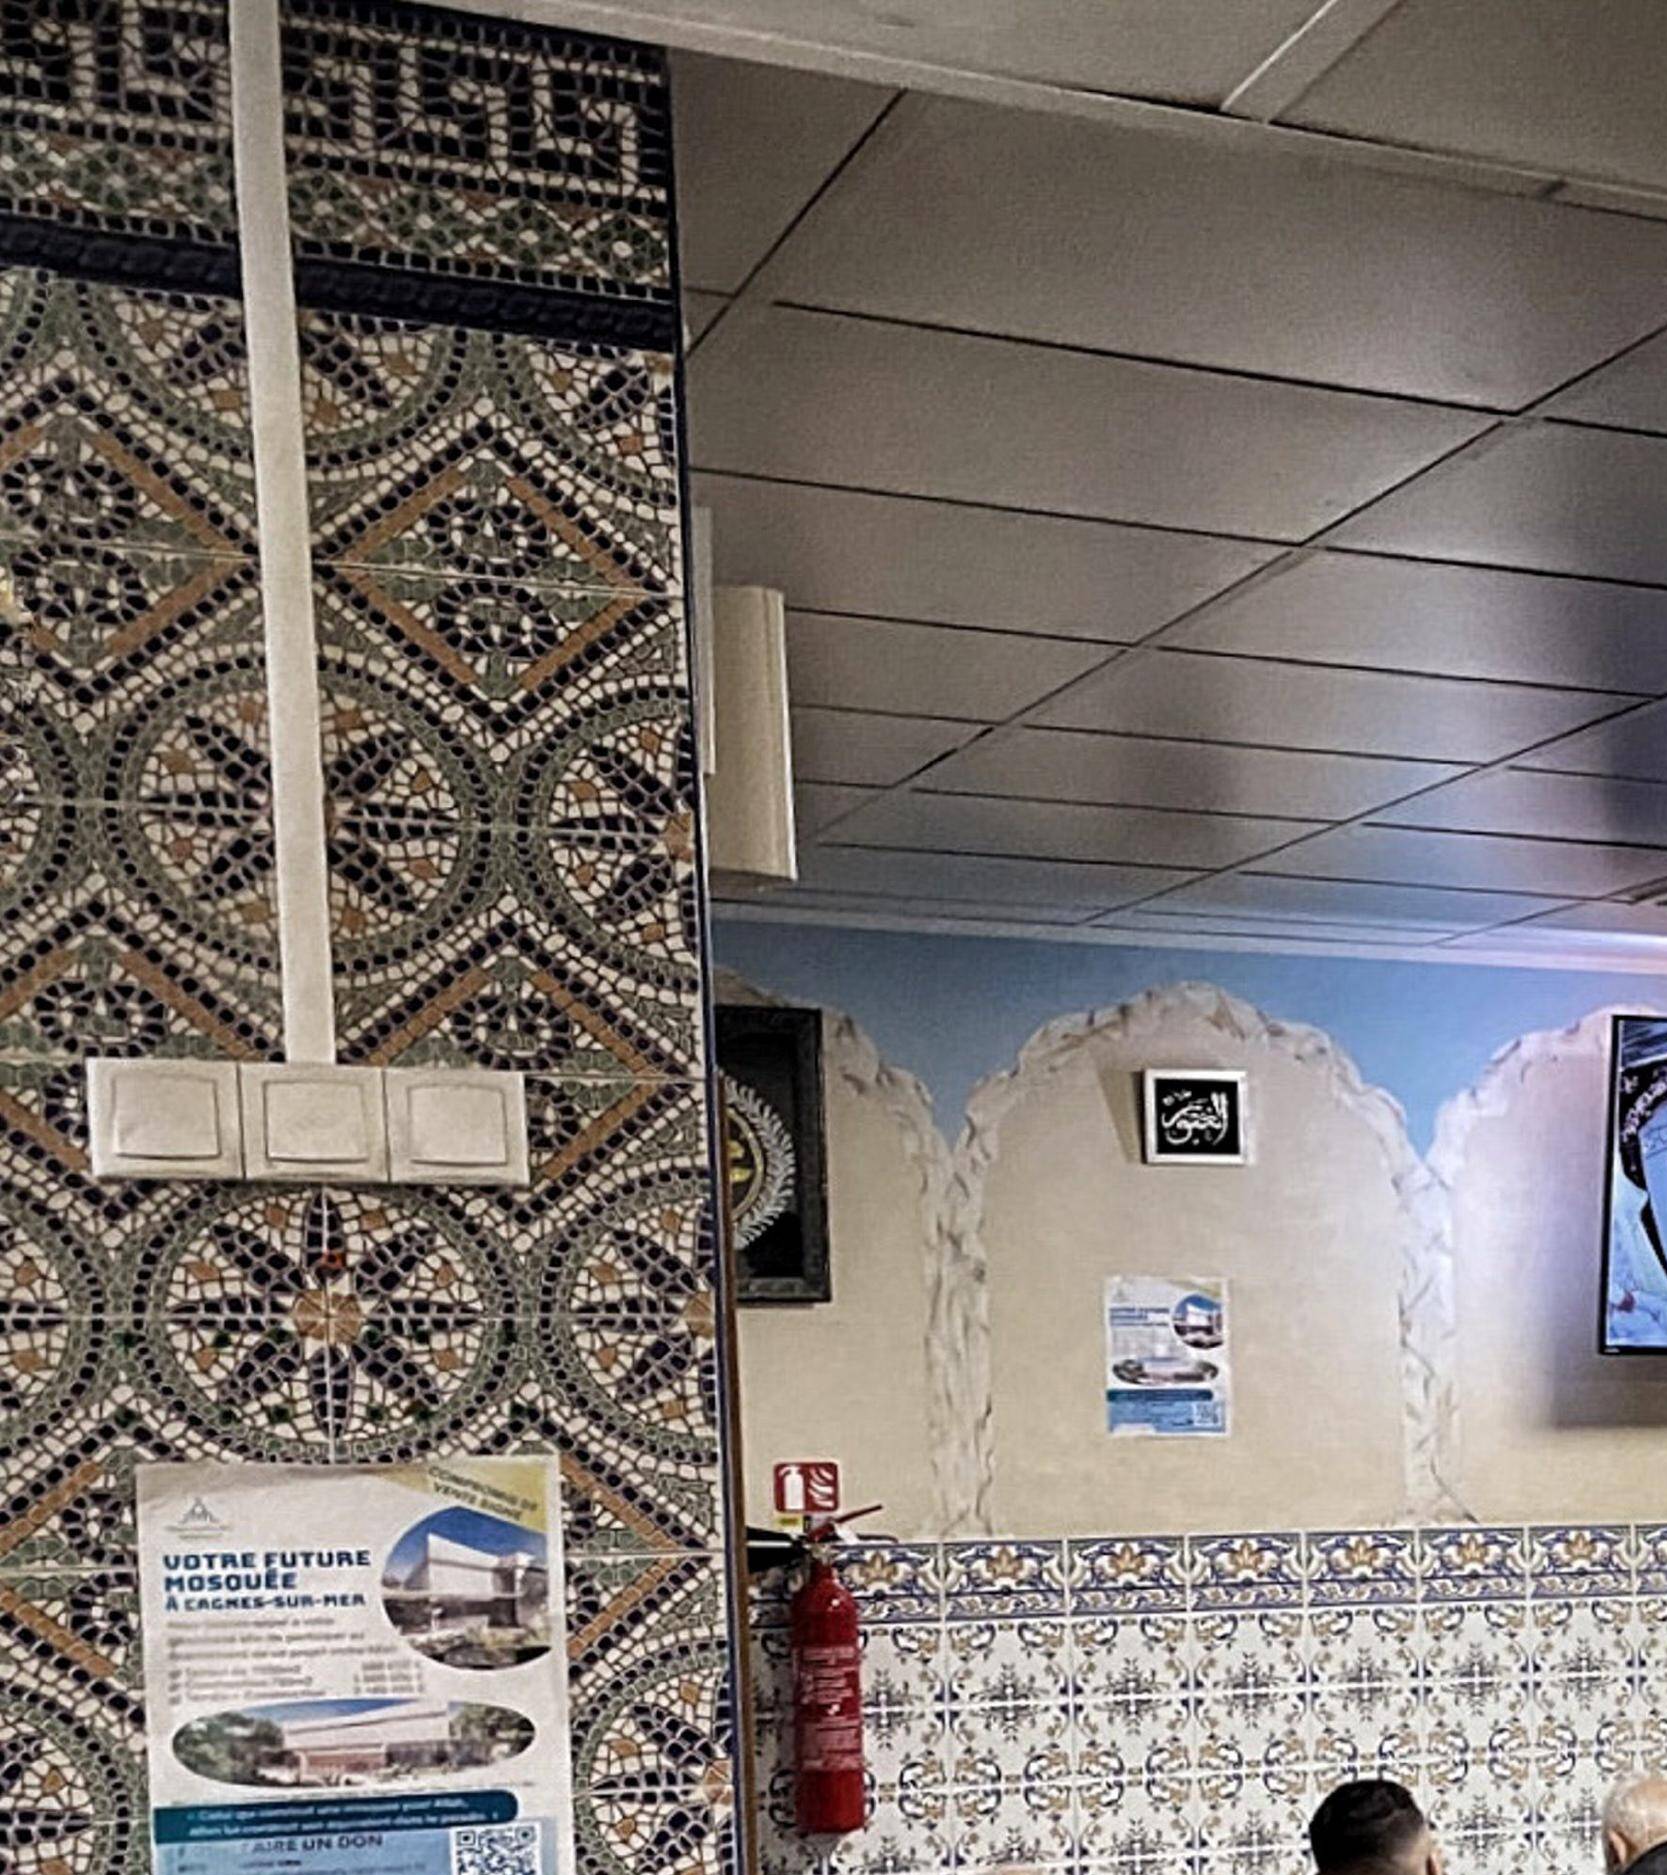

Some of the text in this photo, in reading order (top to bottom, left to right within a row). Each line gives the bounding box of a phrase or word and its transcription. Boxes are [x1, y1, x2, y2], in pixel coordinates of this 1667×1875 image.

[163, 1550, 371, 1570] VOTRE FUTURE
[164, 1569, 297, 1592] MOSQUÉE
[184, 1593, 366, 1611] CAGNES-SUR-MER
[302, 1837, 332, 1851] UN
[338, 1835, 383, 1849] DON
